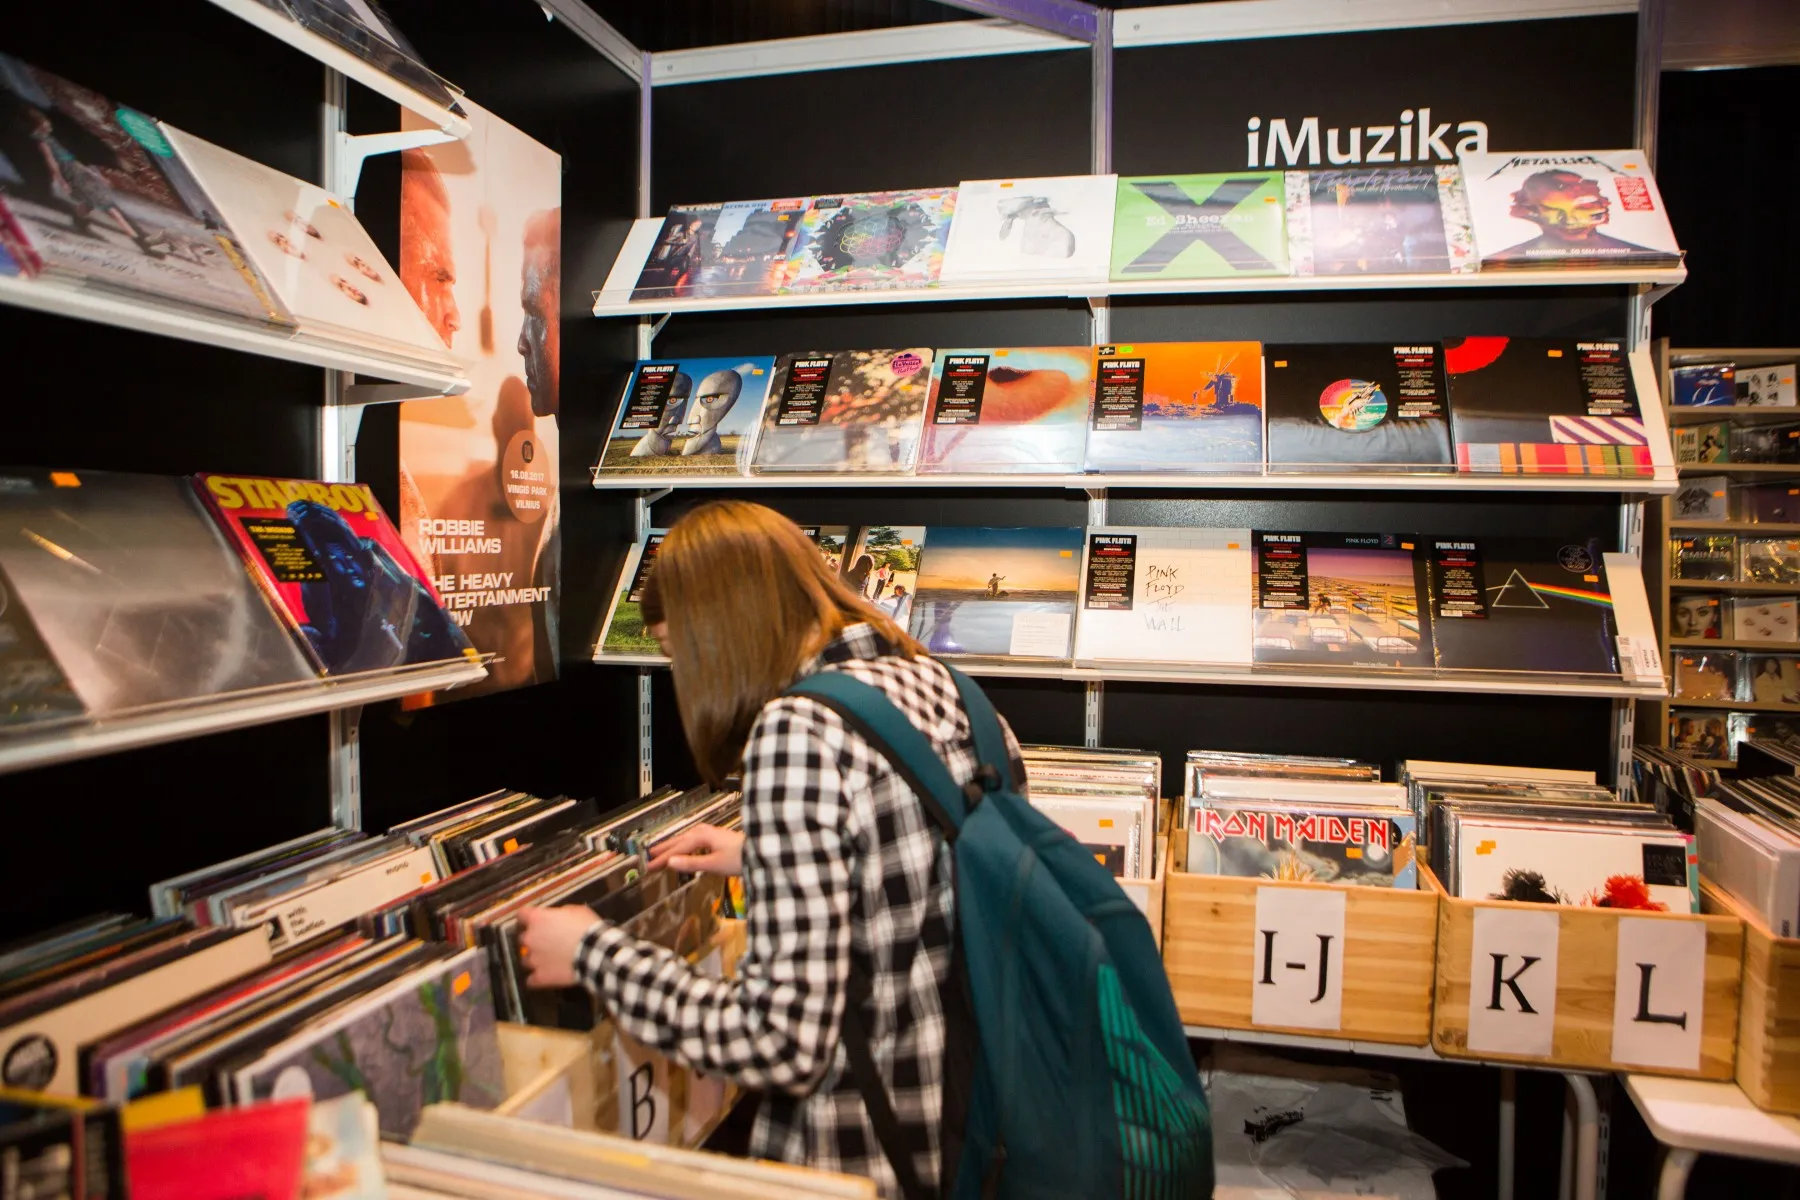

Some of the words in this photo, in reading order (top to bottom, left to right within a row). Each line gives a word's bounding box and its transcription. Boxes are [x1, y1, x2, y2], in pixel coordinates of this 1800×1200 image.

[1248, 107, 1489, 168] iMuzika
[1145, 216, 1166, 226] Ed
[1175, 213, 1254, 226] Sheeran
[1120, 361, 1140, 369] FLOYD
[510, 469, 545, 482] 16.08.2017
[206, 475, 380, 513] STARBOY
[507, 483, 530, 495] VINGIS
[531, 486, 547, 496] PARK
[515, 499, 541, 510] VILNIUS
[418, 518, 485, 536] ROBBIE
[419, 538, 502, 555] WILLIAMS
[1112, 537, 1132, 545] FLOYD
[1280, 535, 1301, 543] FLOYD
[1453, 542, 1476, 550] FLOYD
[460, 572, 514, 590] HEAVY
[1145, 564, 1179, 582] PINK
[1145, 578, 1185, 597] FLOYD
[1144, 613, 1187, 632] WALL
[1194, 807, 1268, 847] IRON
[1271, 813, 1390, 855] MAIDEN
[384, 861, 410, 875] mono
[287, 905, 308, 919] with
[1258, 929, 1334, 1003] I-J
[1485, 952, 1542, 1014] K
[1632, 962, 1688, 1031] L
[628, 1061, 656, 1142] B
